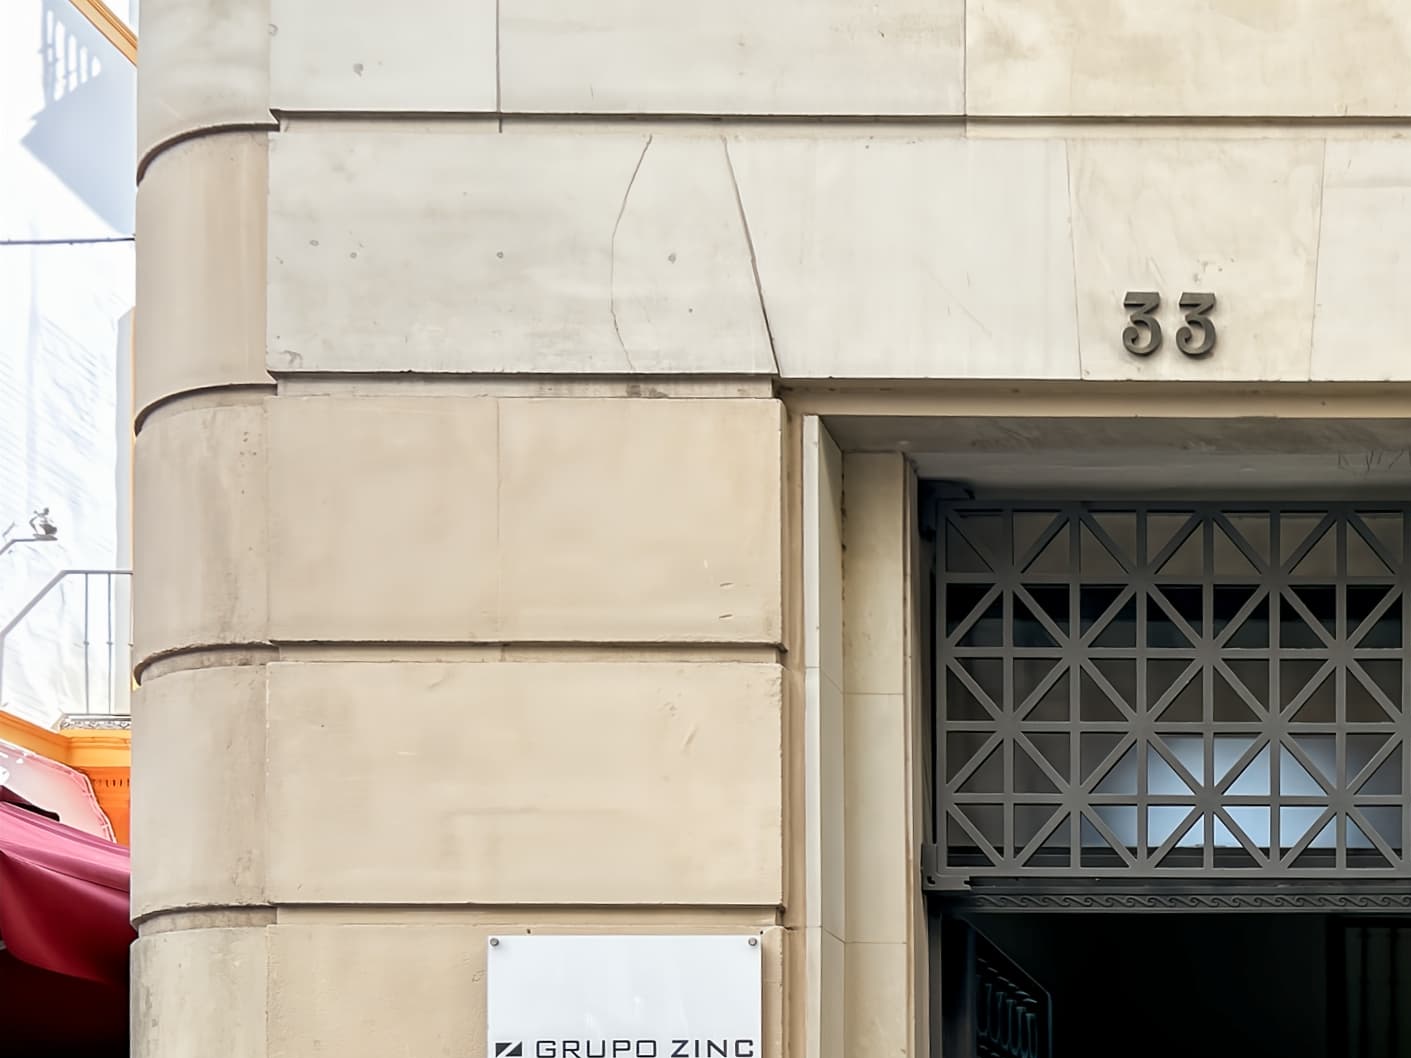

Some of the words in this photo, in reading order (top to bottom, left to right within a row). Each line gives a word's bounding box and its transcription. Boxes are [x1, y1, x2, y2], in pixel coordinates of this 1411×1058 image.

[1122, 291, 1217, 358] 33
[536, 1040, 657, 1058] GRUPO
[671, 1039, 754, 1058] ZINC
